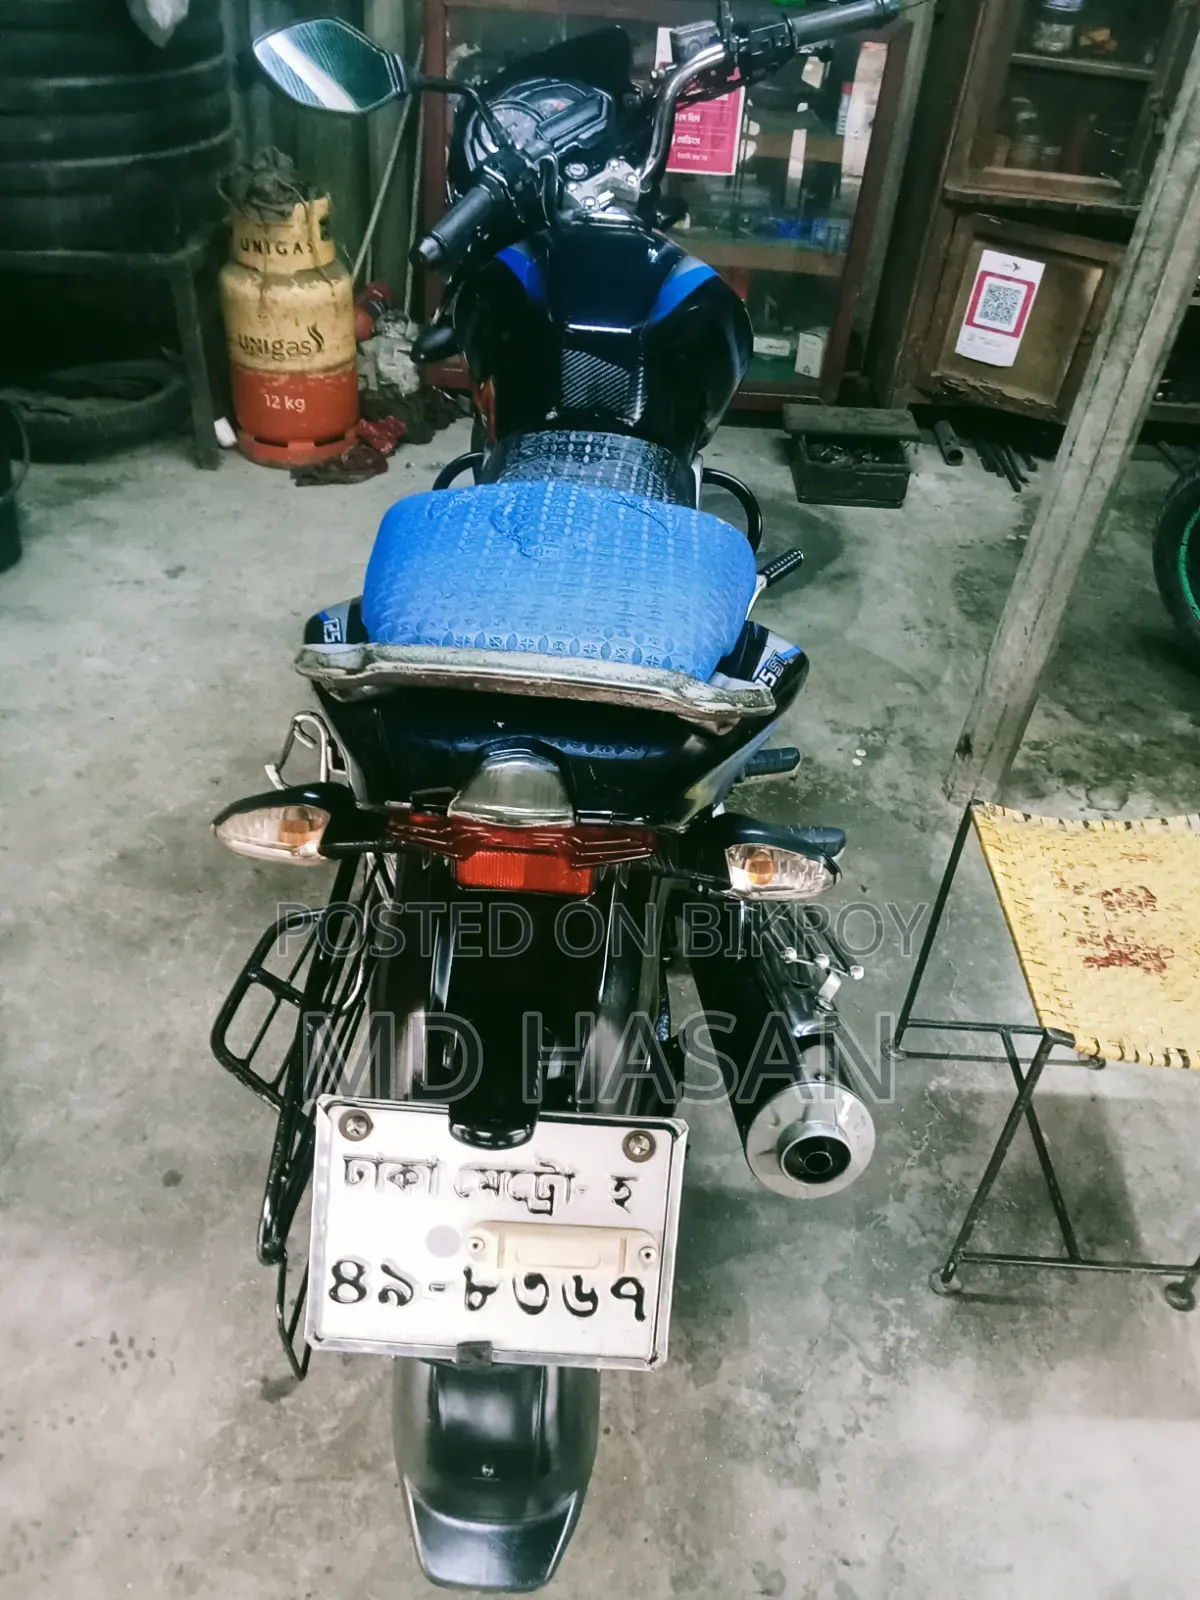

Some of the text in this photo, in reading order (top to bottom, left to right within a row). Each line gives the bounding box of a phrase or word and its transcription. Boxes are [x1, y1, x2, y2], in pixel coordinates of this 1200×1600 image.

[240, 238, 314, 256] UNIGAS
[264, 393, 306, 414] 12 kg
[323, 616, 342, 644] 125
[754, 648, 789, 688] 5ST
[342, 1154, 439, 1196] ঢাকা
[608, 1174, 640, 1215] হ
